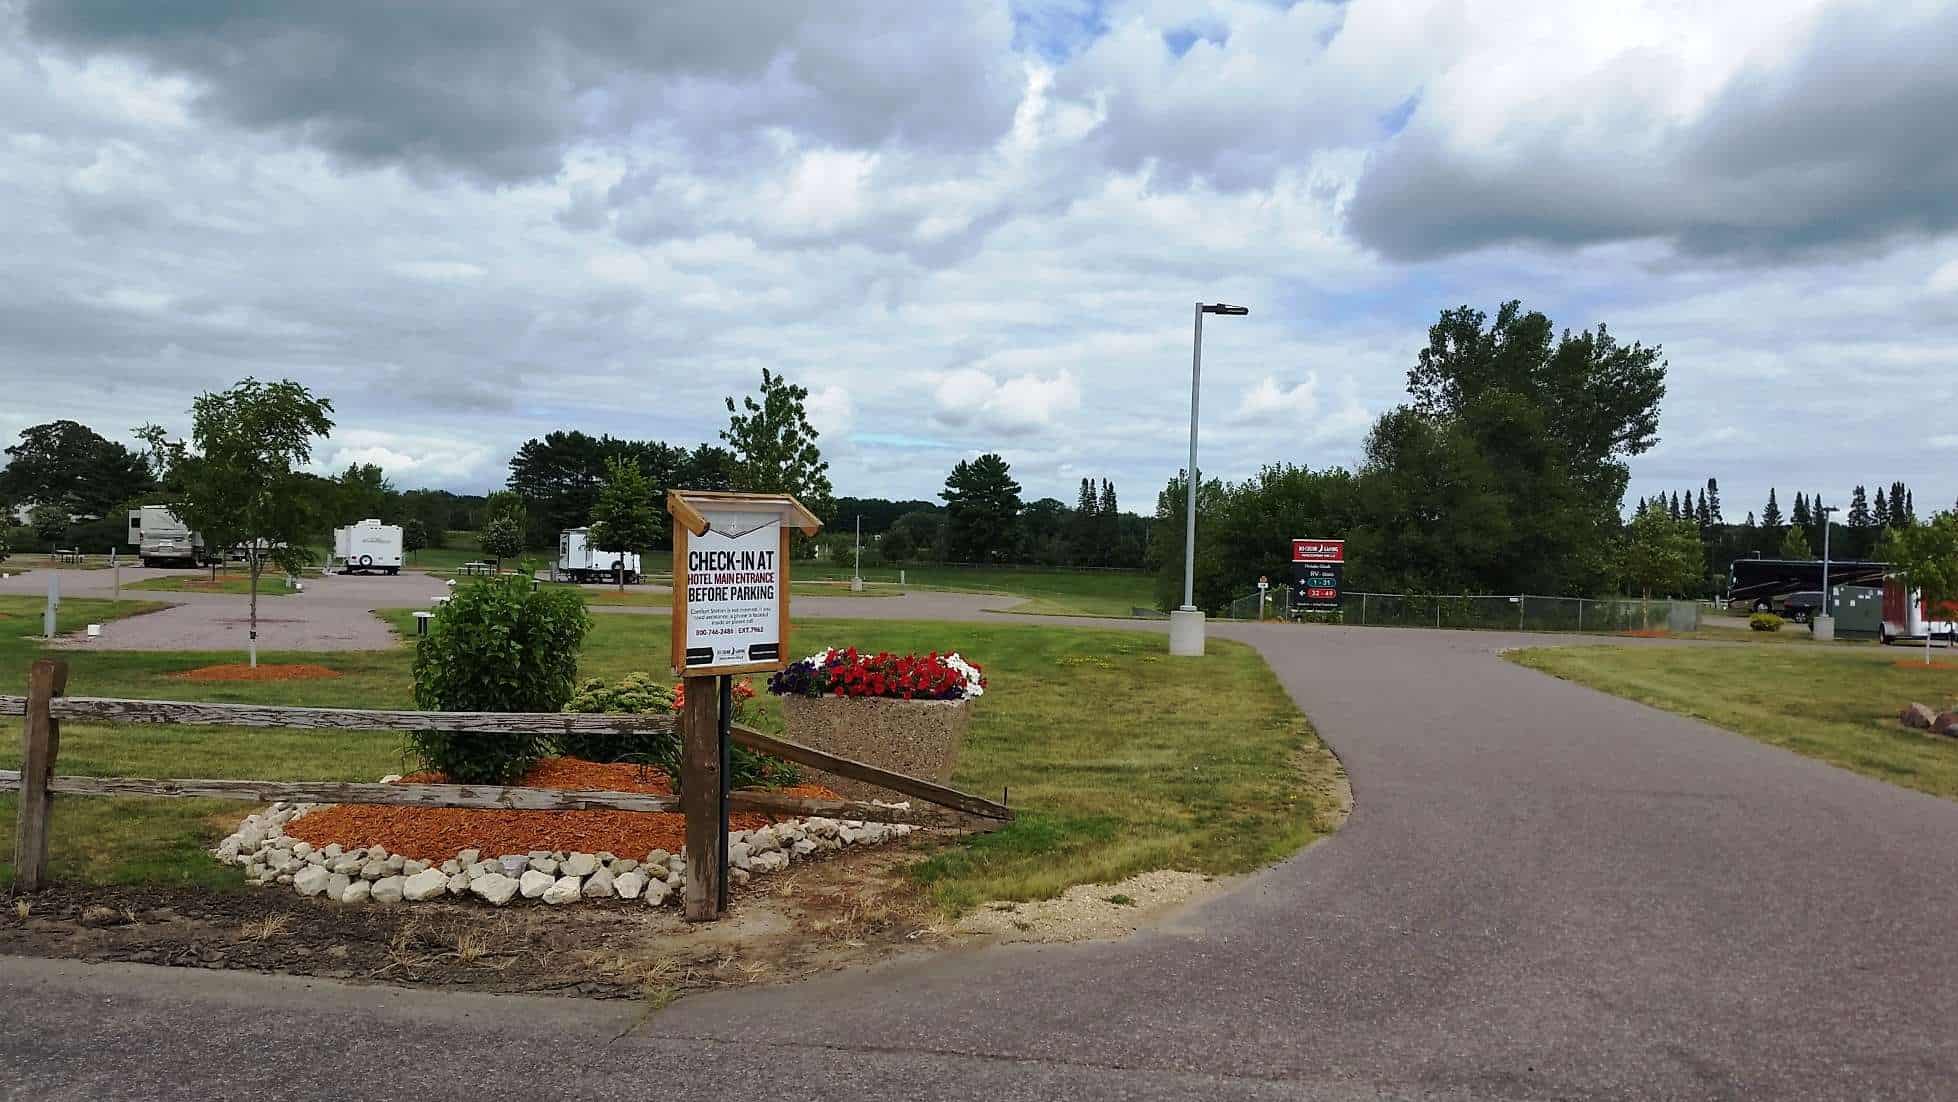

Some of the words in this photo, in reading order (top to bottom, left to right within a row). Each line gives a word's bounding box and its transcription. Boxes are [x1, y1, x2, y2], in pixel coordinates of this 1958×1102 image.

[689, 551, 754, 571] CHECK-IN
[757, 551, 774, 570] AT
[688, 574, 712, 585] HOTEL
[714, 573, 734, 584] MAIN
[736, 572, 774, 584] ENTRANCE
[689, 587, 728, 602] BEFORE
[731, 585, 774, 600] PARKING
